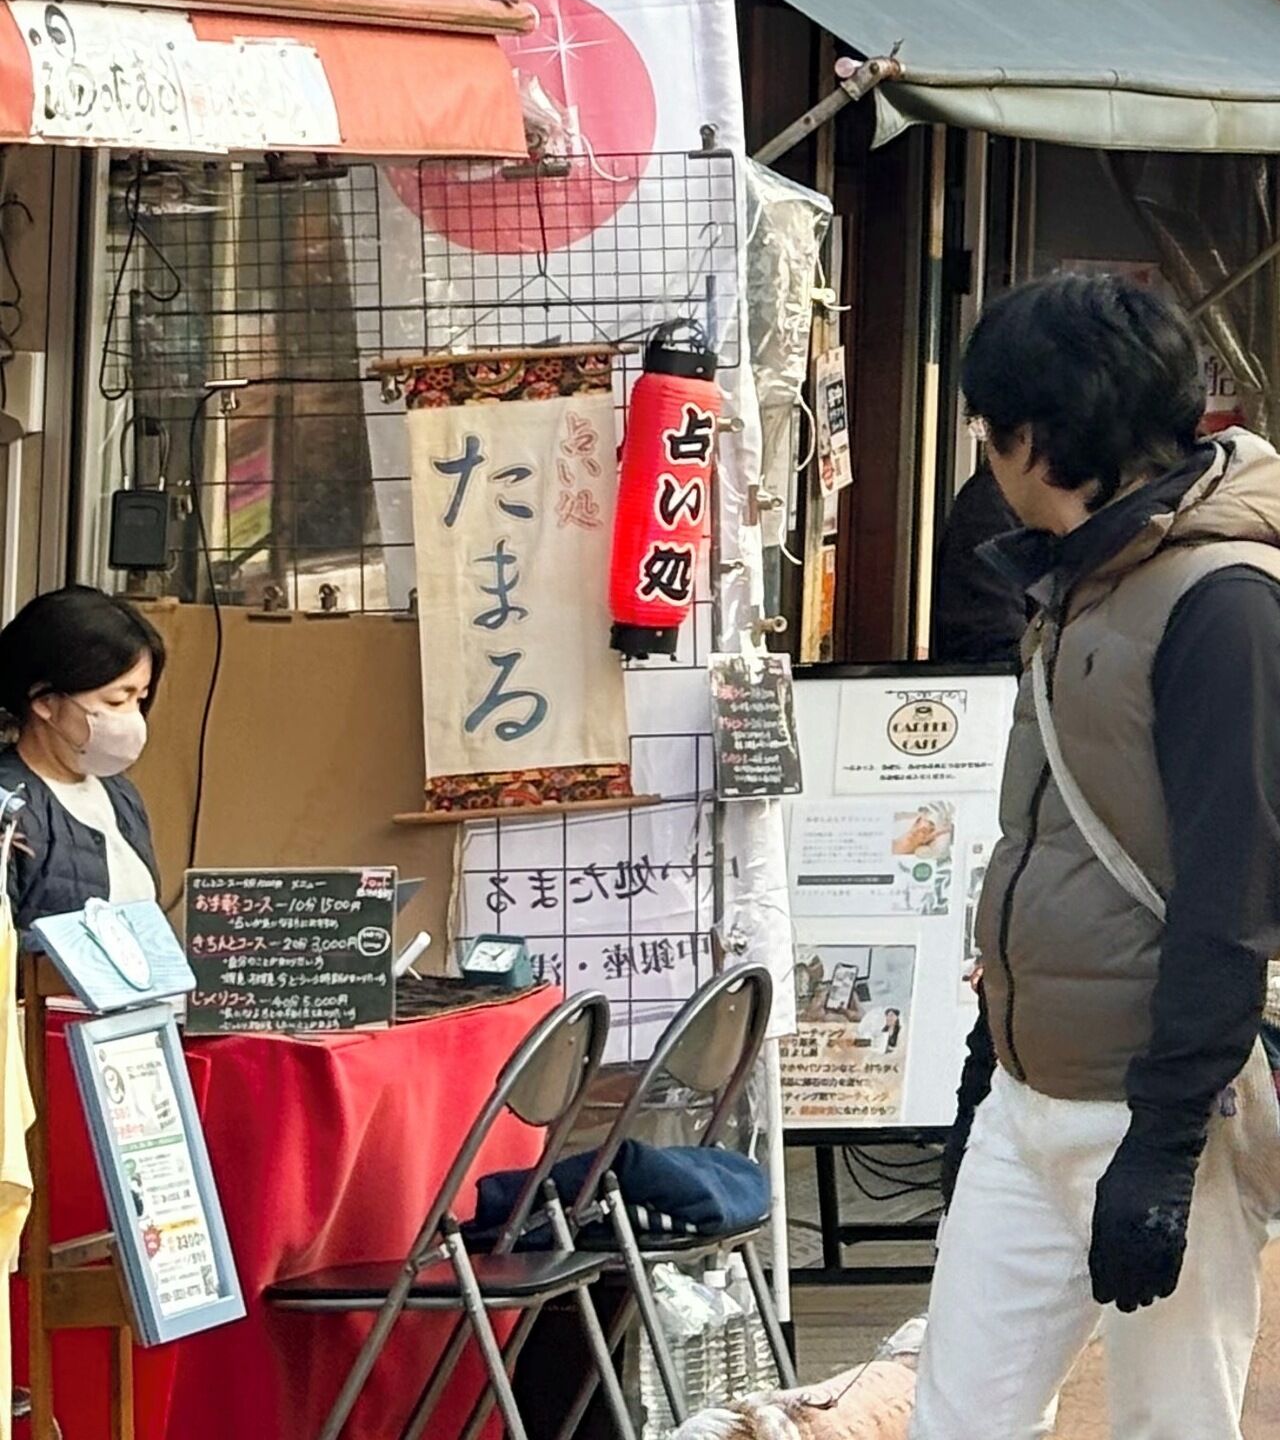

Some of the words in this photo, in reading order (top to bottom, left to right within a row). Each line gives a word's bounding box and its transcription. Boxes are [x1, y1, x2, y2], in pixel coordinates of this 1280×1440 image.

[558, 410, 605, 532] 占い処
[637, 403, 716, 605] 占い処
[431, 434, 551, 742] たまる
